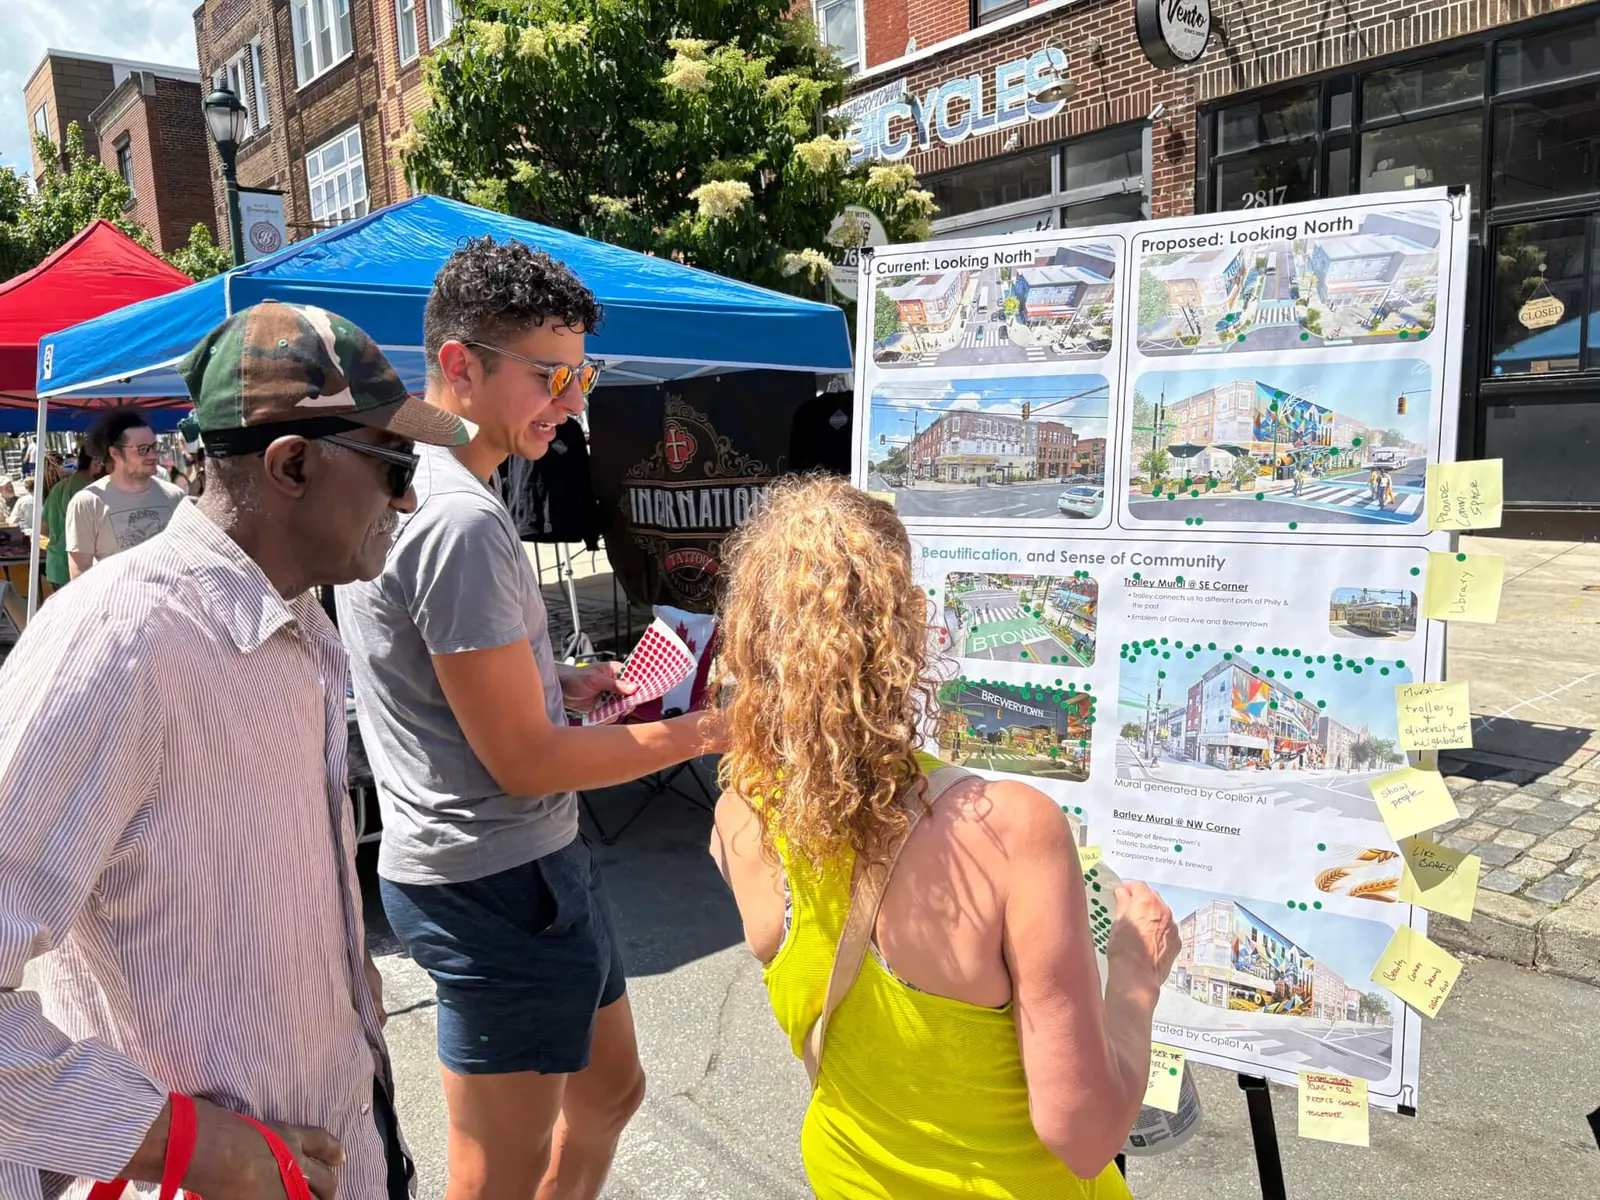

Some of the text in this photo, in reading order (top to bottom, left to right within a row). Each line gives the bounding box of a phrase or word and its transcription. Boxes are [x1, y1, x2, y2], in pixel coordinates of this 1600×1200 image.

[1161, 0, 1207, 28] Vento
[844, 47, 1068, 164] BICYCLES
[1242, 185, 1288, 209] 2817
[1142, 216, 1353, 252] Proposed: Looking North
[876, 250, 1032, 274] Current: Looking North
[1521, 306, 1563, 322] CLOSED
[922, 547, 1226, 571] Beautification, and Sense of Community
[1123, 577, 1249, 592] Trolley Mural @ SE Corner
[1204, 595, 1234, 604] different
[1235, 597, 1253, 605] parts
[1263, 599, 1282, 607] Philly
[1168, 616, 1189, 624] Girard
[1190, 617, 1205, 625] Ave
[1206, 618, 1221, 626] and
[1222, 619, 1268, 628] Brewerytown
[972, 625, 1049, 652] BTOWN
[981, 690, 1044, 717] BREWERYTOWN
[1405, 722, 1468, 738] diversity of
[1114, 778, 1267, 805] Mural generated by Copilot AI
[1113, 809, 1241, 835] Barley Mural @ NW Corner
[1116, 839, 1169, 853] historic buildings
[1117, 829, 1143, 840] Collage
[1152, 834, 1201, 847] Brewerytown's
[1115, 850, 1154, 862] Incorporate
[1155, 856, 1177, 866] barley
[1184, 860, 1213, 872] brewing
[1152, 1023, 1254, 1052] erated by Copilot AI
